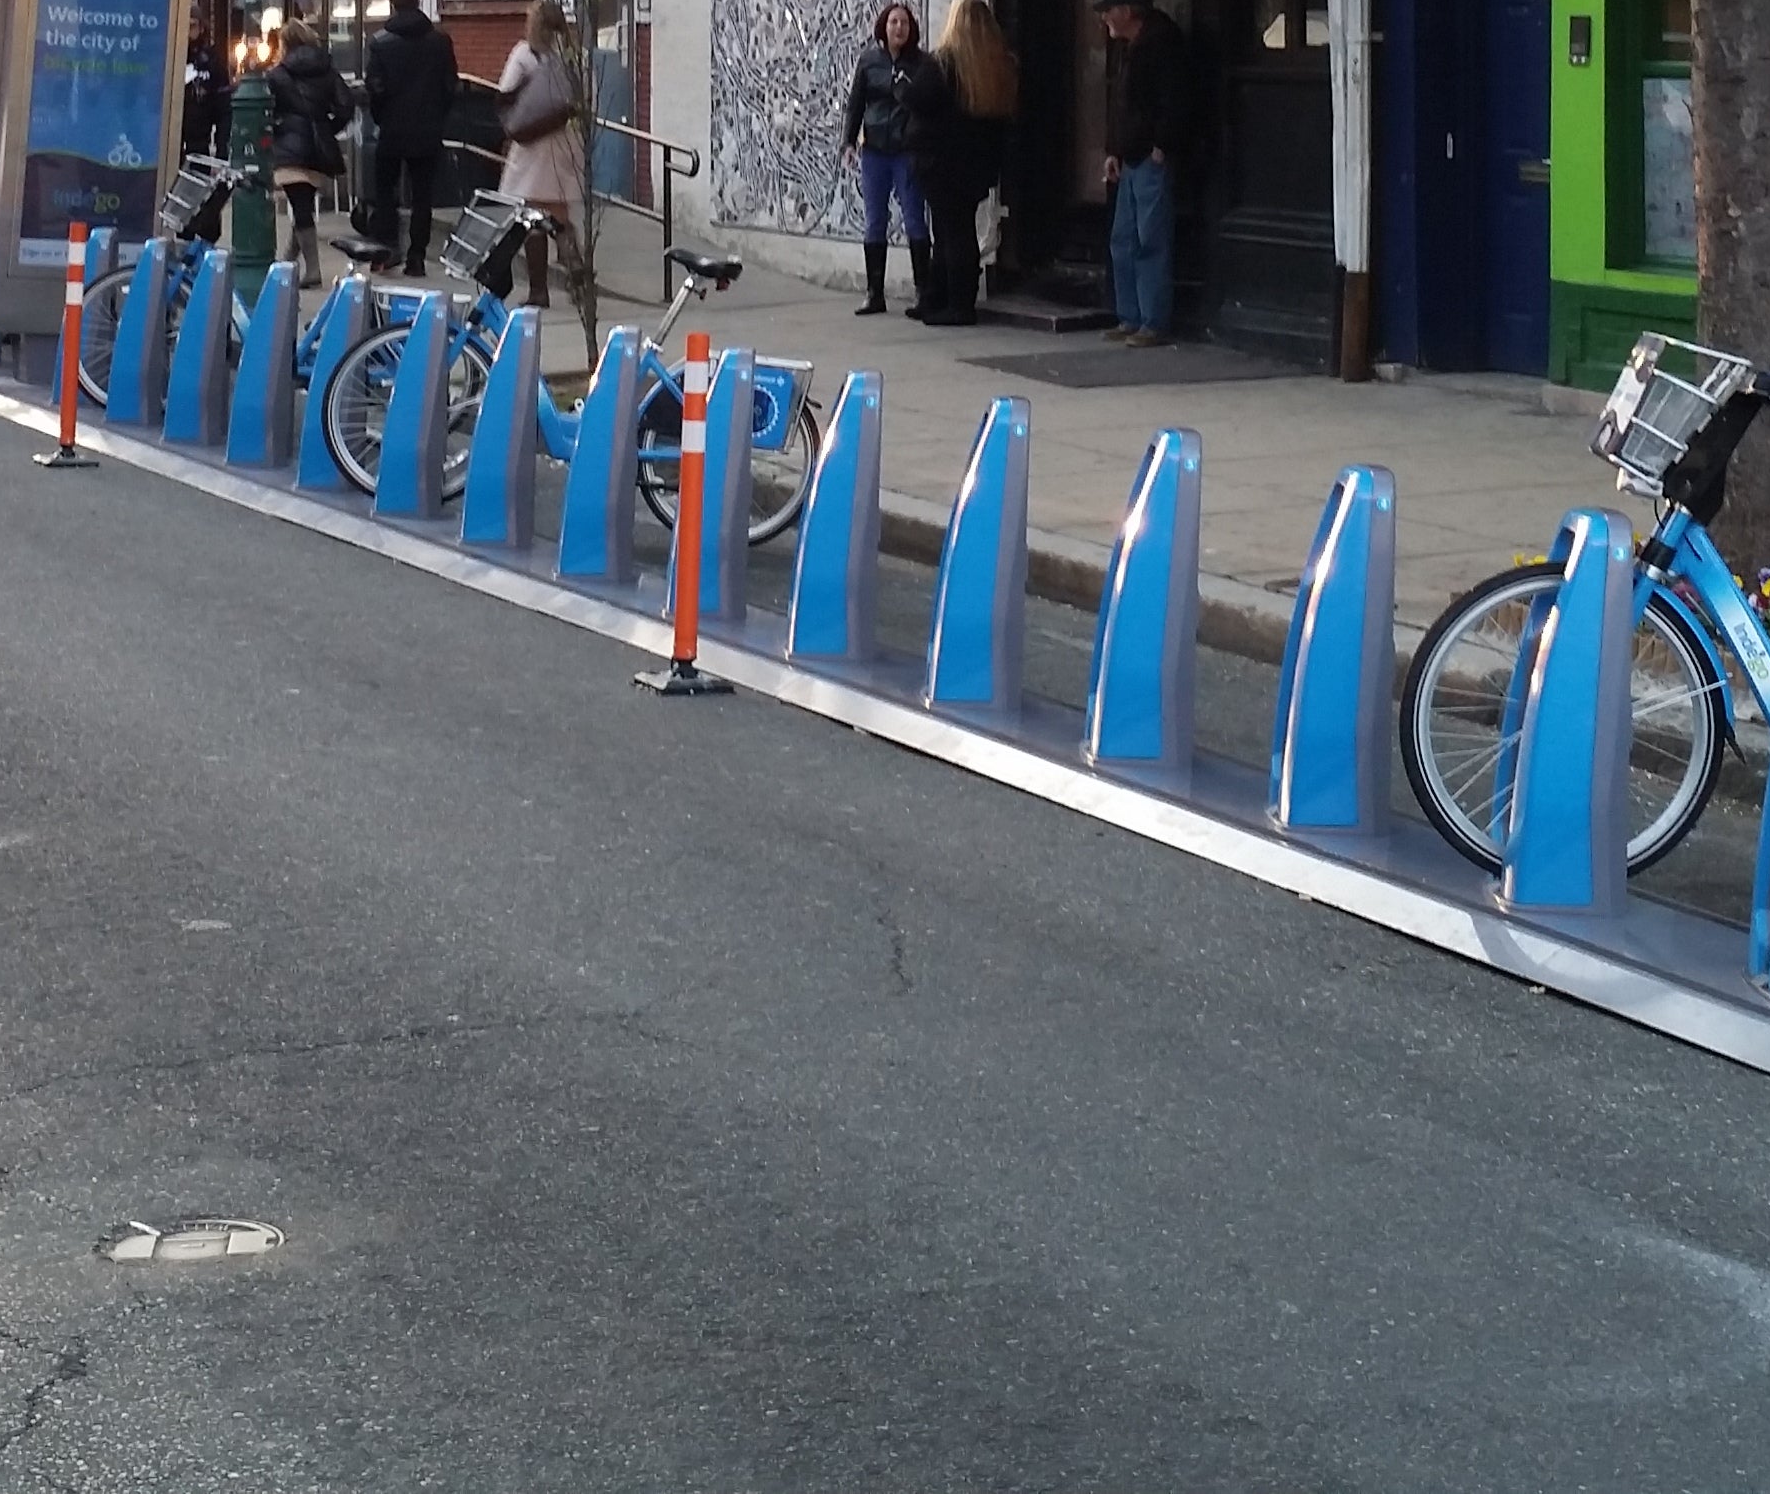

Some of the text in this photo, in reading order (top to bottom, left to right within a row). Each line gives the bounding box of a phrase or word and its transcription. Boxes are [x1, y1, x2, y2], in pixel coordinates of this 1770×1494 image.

[48, 5, 158, 28] Welcome to
[46, 28, 141, 54] the city of
